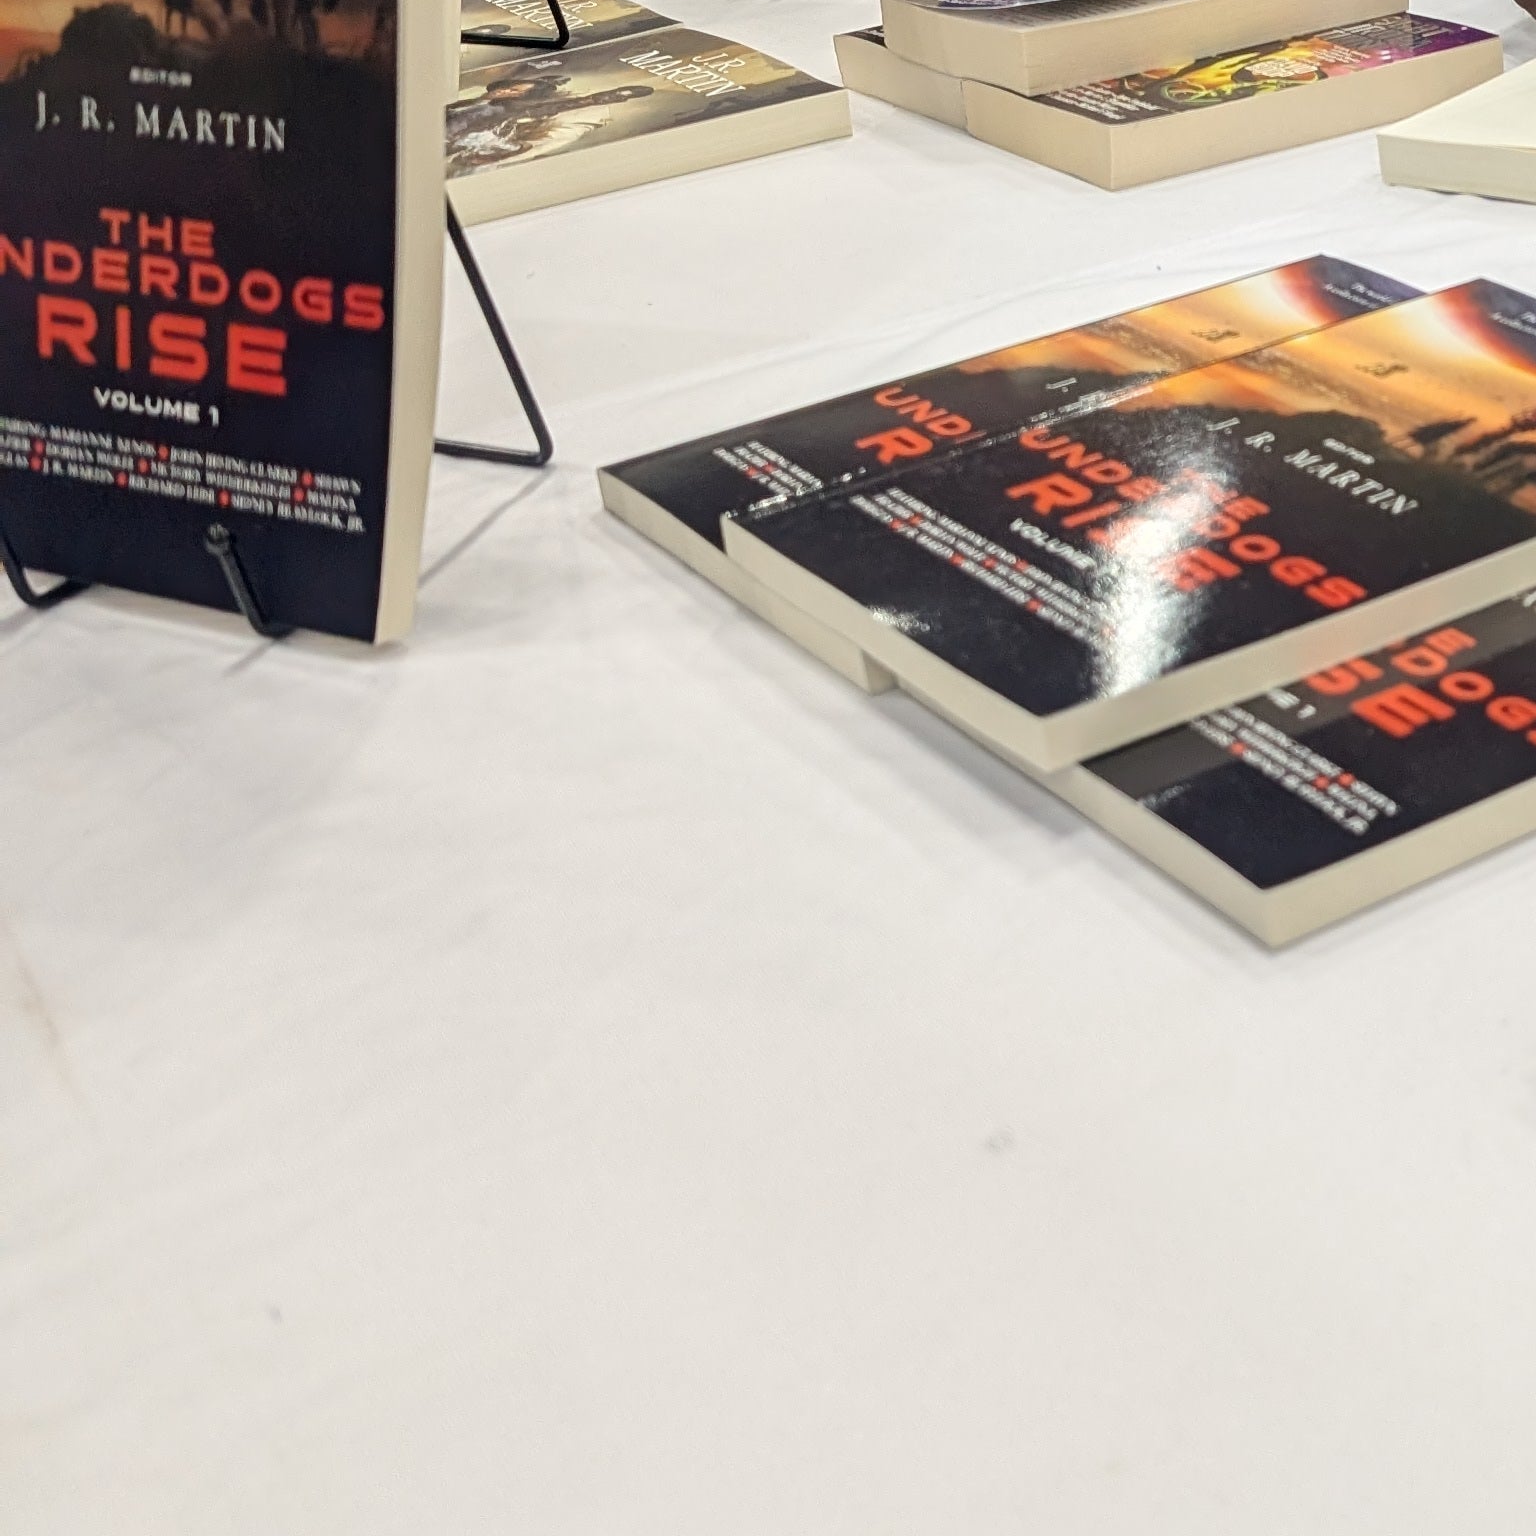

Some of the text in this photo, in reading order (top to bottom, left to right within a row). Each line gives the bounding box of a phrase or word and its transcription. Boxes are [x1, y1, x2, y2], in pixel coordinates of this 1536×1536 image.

[129, 66, 192, 87] EDITOR
[620, 50, 746, 97] MARTIN
[35, 90, 287, 153] J. R. MARTIN
[99, 207, 216, 260] THE
[0, 233, 386, 332] NDERDOGS
[35, 292, 289, 397] RISE
[93, 384, 220, 428] VOLUME 1
[1282, 448, 1419, 515] MARTIN
